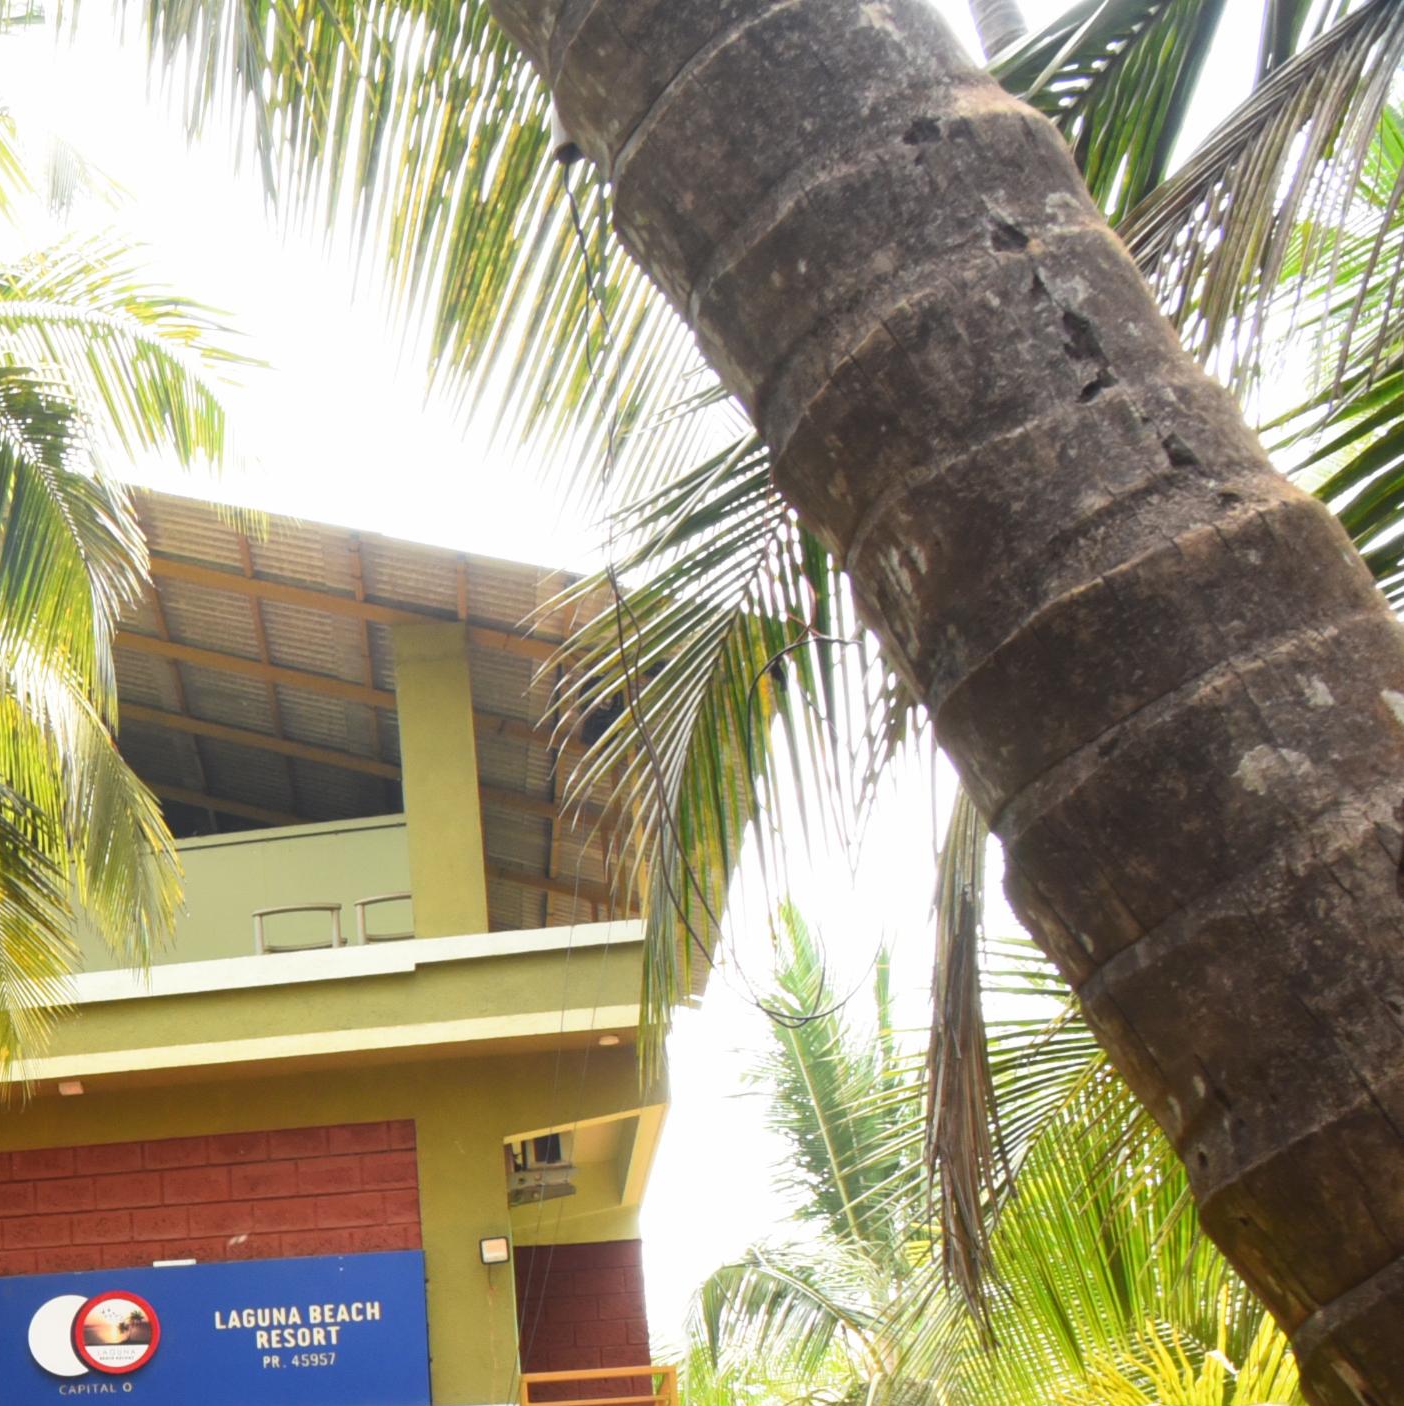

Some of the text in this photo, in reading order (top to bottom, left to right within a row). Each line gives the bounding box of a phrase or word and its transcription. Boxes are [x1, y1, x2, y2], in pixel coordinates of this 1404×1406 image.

[214, 1301, 381, 1330] LAGUNA BEACH
[255, 1325, 341, 1350] RESORT
[262, 1352, 336, 1369] PR. 45957
[58, 1382, 133, 1396] CAPITAL O
